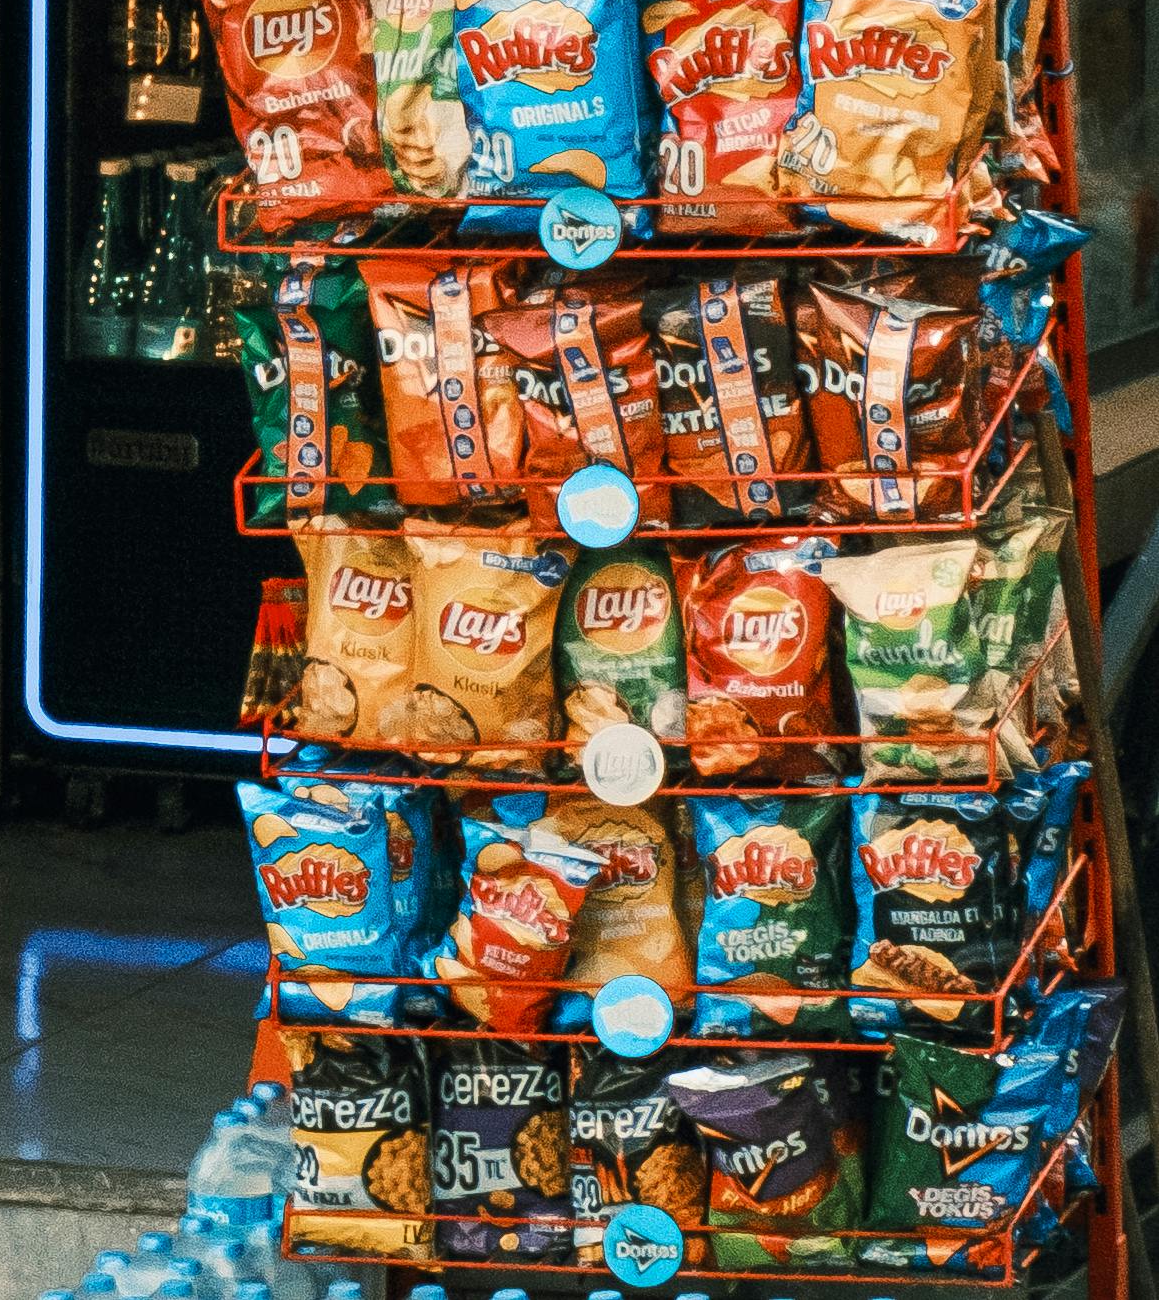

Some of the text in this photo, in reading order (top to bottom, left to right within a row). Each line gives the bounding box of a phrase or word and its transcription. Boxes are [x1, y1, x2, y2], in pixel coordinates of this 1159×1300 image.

[253, 1, 333, 58] Lay's
[458, 15, 598, 90] Ruffles
[806, 23, 954, 82] Ruffles
[648, 25, 793, 105] Ruffles
[512, 96, 605, 129] ORIGINALS
[658, 138, 706, 197] 20
[792, 113, 838, 176] 20
[331, 566, 413, 620] Lay's
[584, 580, 666, 633] Lay's
[340, 642, 391, 661] Klasik
[441, 601, 523, 655] Lay's
[729, 608, 801, 654] Lay's
[258, 857, 371, 912] Ruffles
[707, 840, 818, 899] Ruffles
[859, 834, 982, 893] Ruffles
[716, 1130, 807, 1175] ritos
[906, 1106, 1030, 1151] Doritos
[434, 1130, 481, 1192] 35
